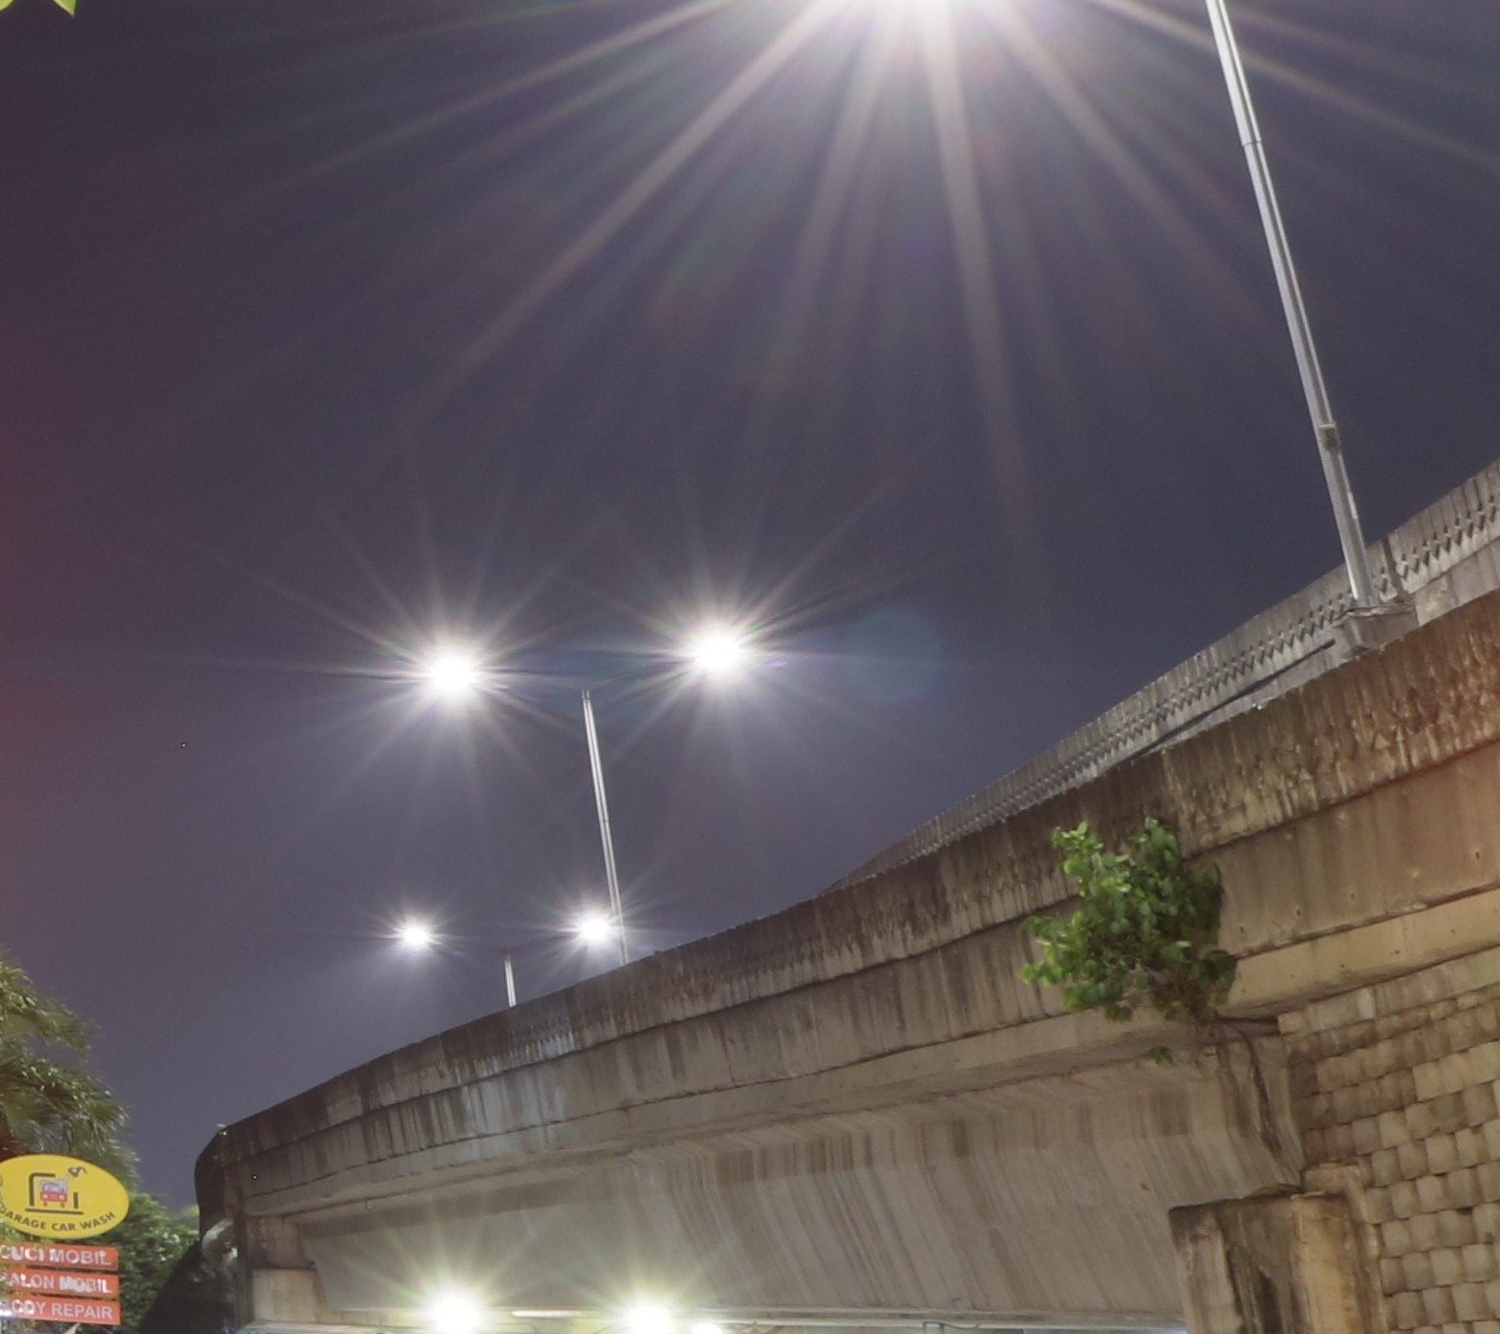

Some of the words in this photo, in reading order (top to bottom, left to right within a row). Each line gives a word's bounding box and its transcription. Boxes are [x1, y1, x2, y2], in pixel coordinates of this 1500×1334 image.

[51, 1222, 77, 1232] CAR
[79, 1211, 117, 1230] WASH
[49, 1248, 112, 1266] MOBIL
[60, 1275, 113, 1294] MOBIL
[51, 1302, 114, 1320] REPAIR
